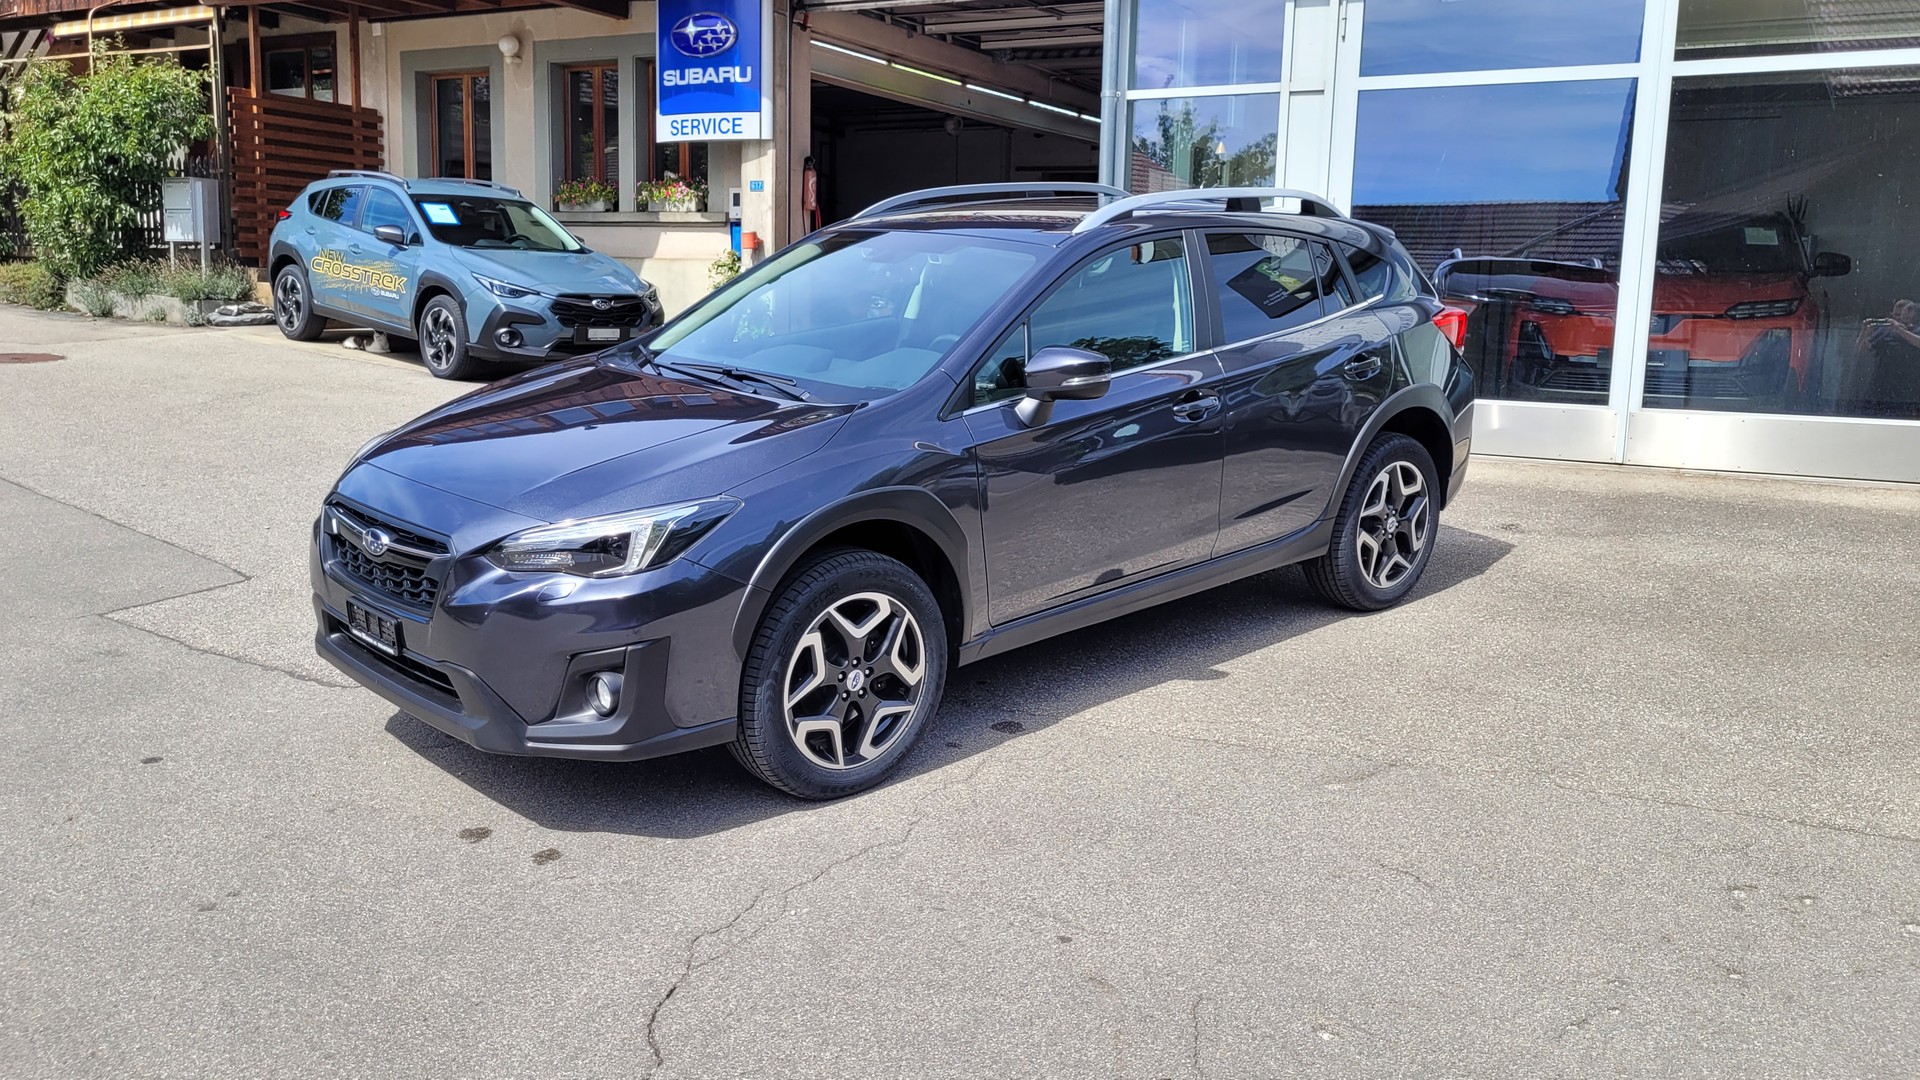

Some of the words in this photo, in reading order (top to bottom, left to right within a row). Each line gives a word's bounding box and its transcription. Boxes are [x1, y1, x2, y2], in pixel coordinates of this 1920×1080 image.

[663, 66, 752, 87] SUBARU
[670, 117, 743, 136] SERVICE
[319, 248, 346, 262] NEW
